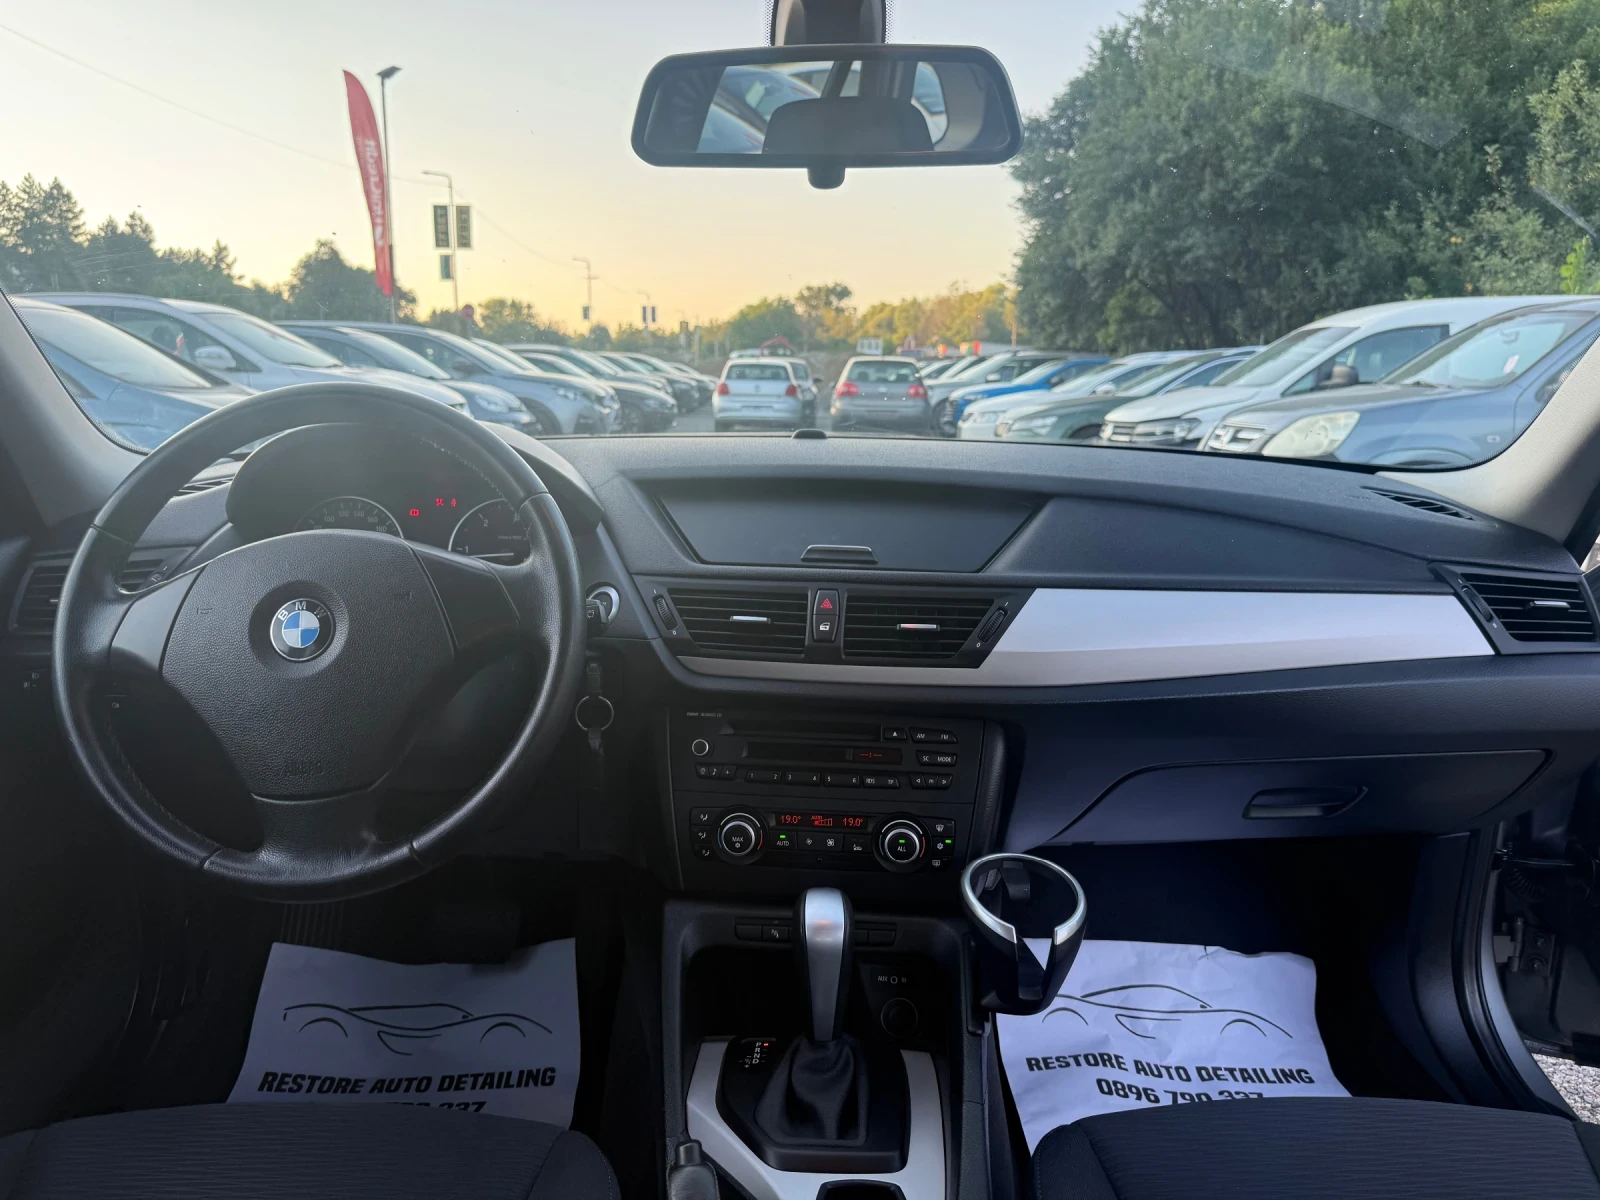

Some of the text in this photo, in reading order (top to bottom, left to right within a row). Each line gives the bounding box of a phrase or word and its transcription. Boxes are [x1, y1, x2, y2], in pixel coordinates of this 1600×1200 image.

[278, 601, 327, 621] BMW
[258, 1067, 556, 1094] RESTORE AUTO DETAILING
[1026, 1052, 1315, 1084] RESTORE AUTO DETAILING
[1096, 1078, 1160, 1104] 0896
